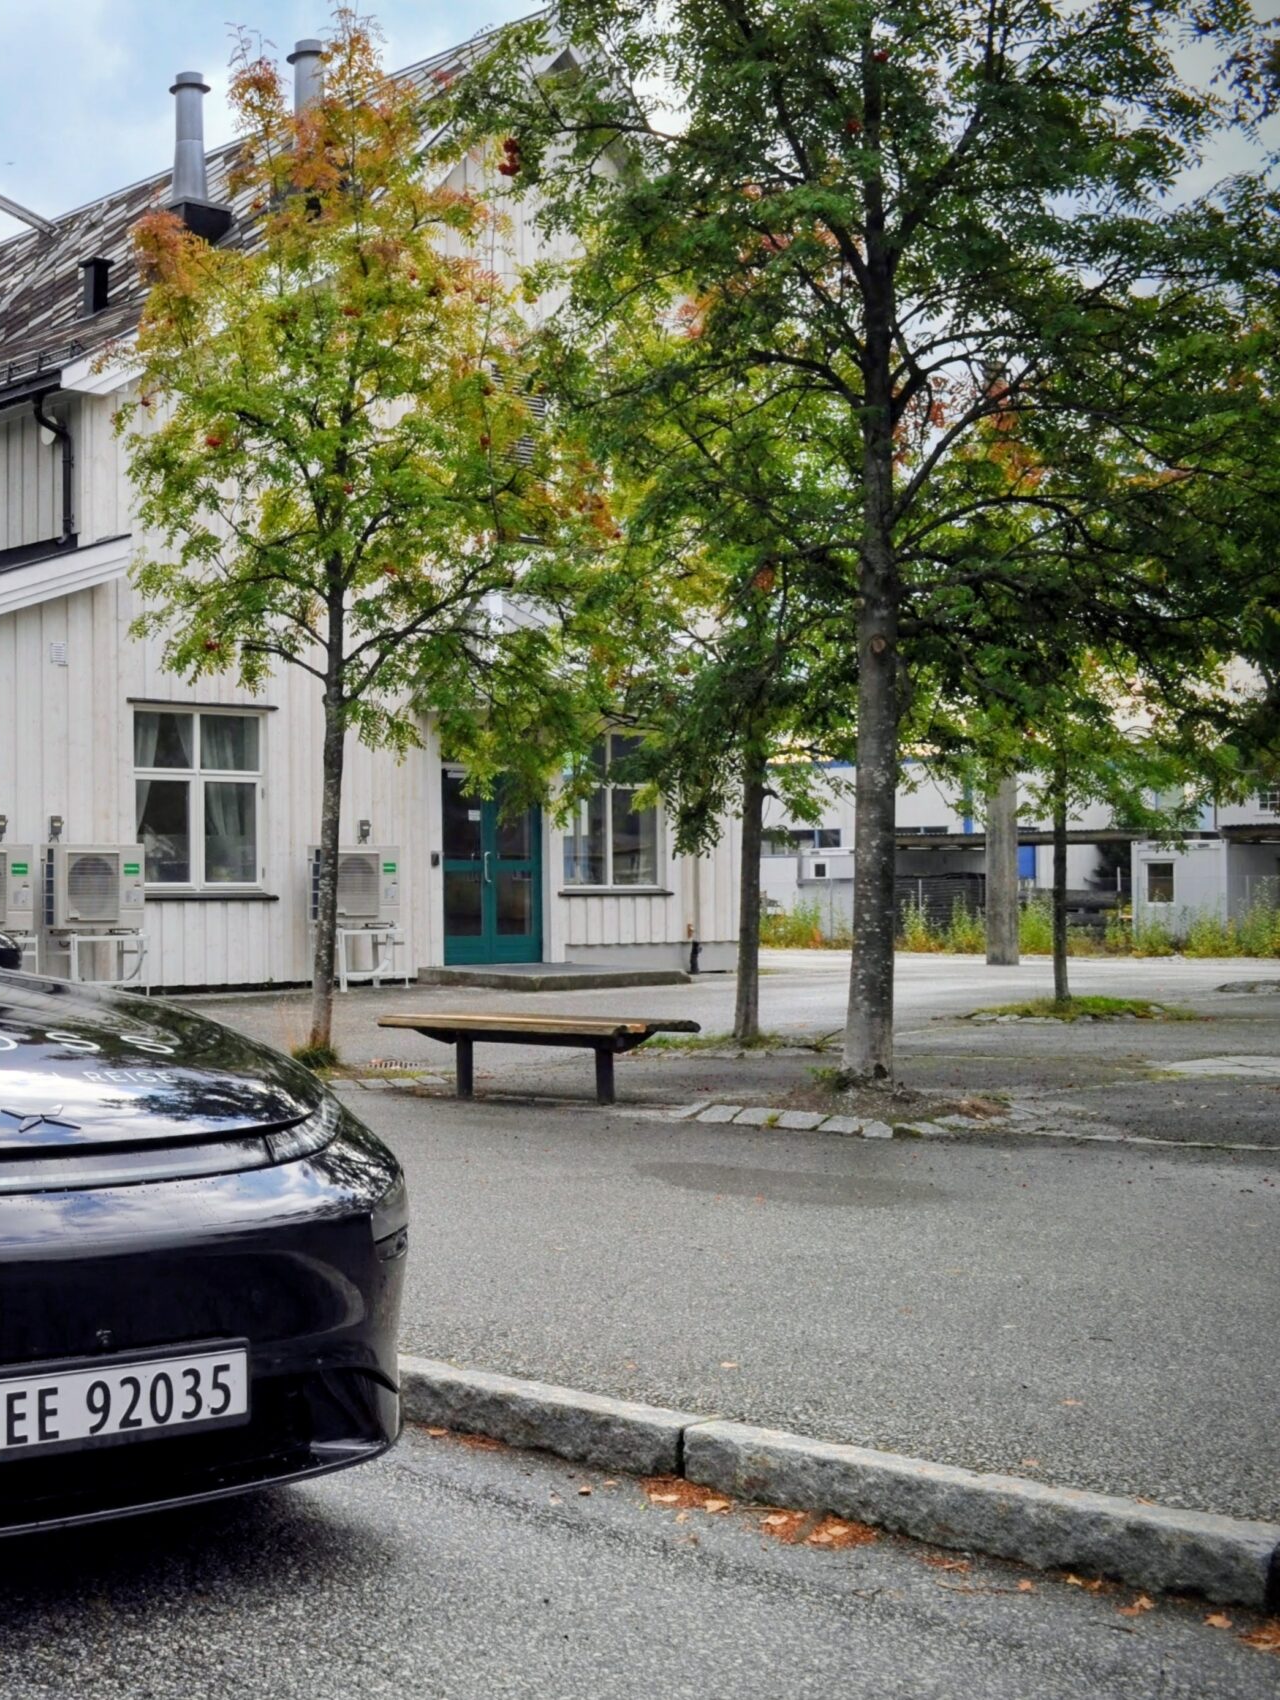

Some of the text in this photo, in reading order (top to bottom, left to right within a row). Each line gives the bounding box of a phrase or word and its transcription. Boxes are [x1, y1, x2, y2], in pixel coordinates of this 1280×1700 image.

[82, 1070, 178, 1083] REISE
[6, 1363, 231, 1446] EE 92035
